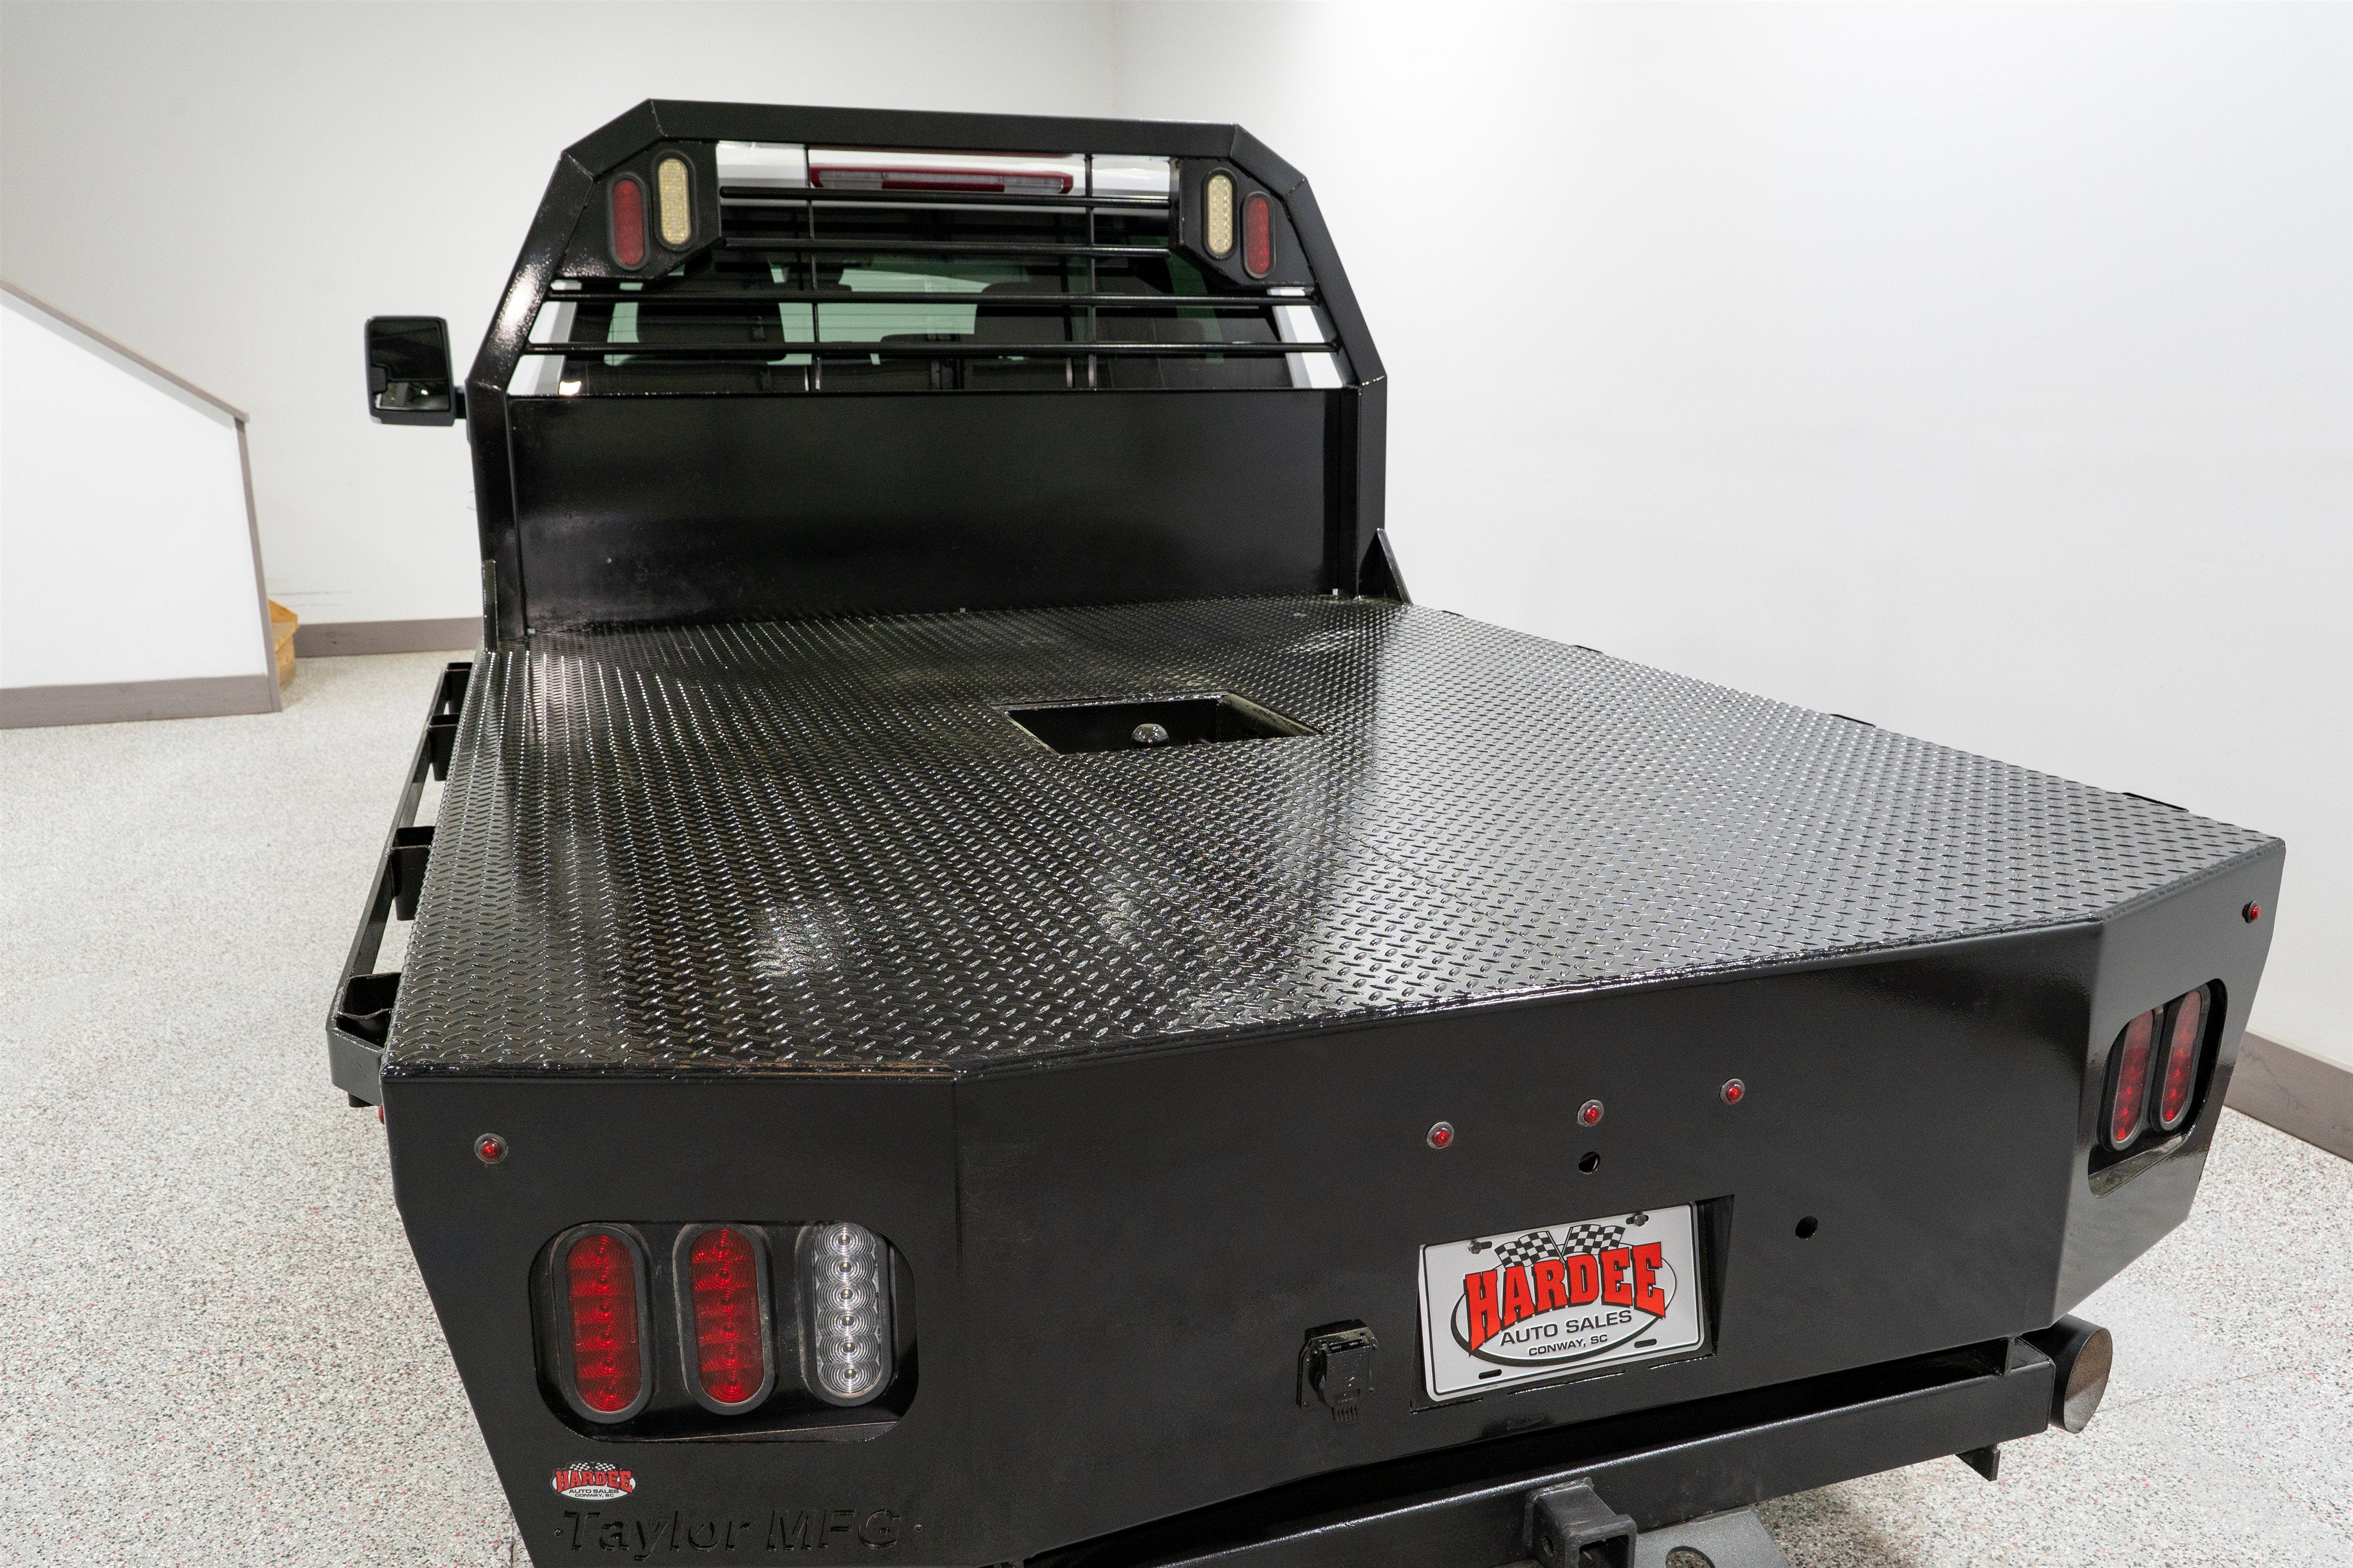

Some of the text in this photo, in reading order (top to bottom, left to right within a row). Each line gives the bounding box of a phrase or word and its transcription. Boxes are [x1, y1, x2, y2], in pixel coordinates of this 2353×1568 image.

[1464, 1242, 1666, 1357] HARDEE
[1500, 1310, 1632, 1346] AUTO SALES
[1528, 1334, 1608, 1356] CONWAY, SC
[556, 1470, 632, 1493] HARDEE
[564, 1508, 903, 1562] Taylor MFG
